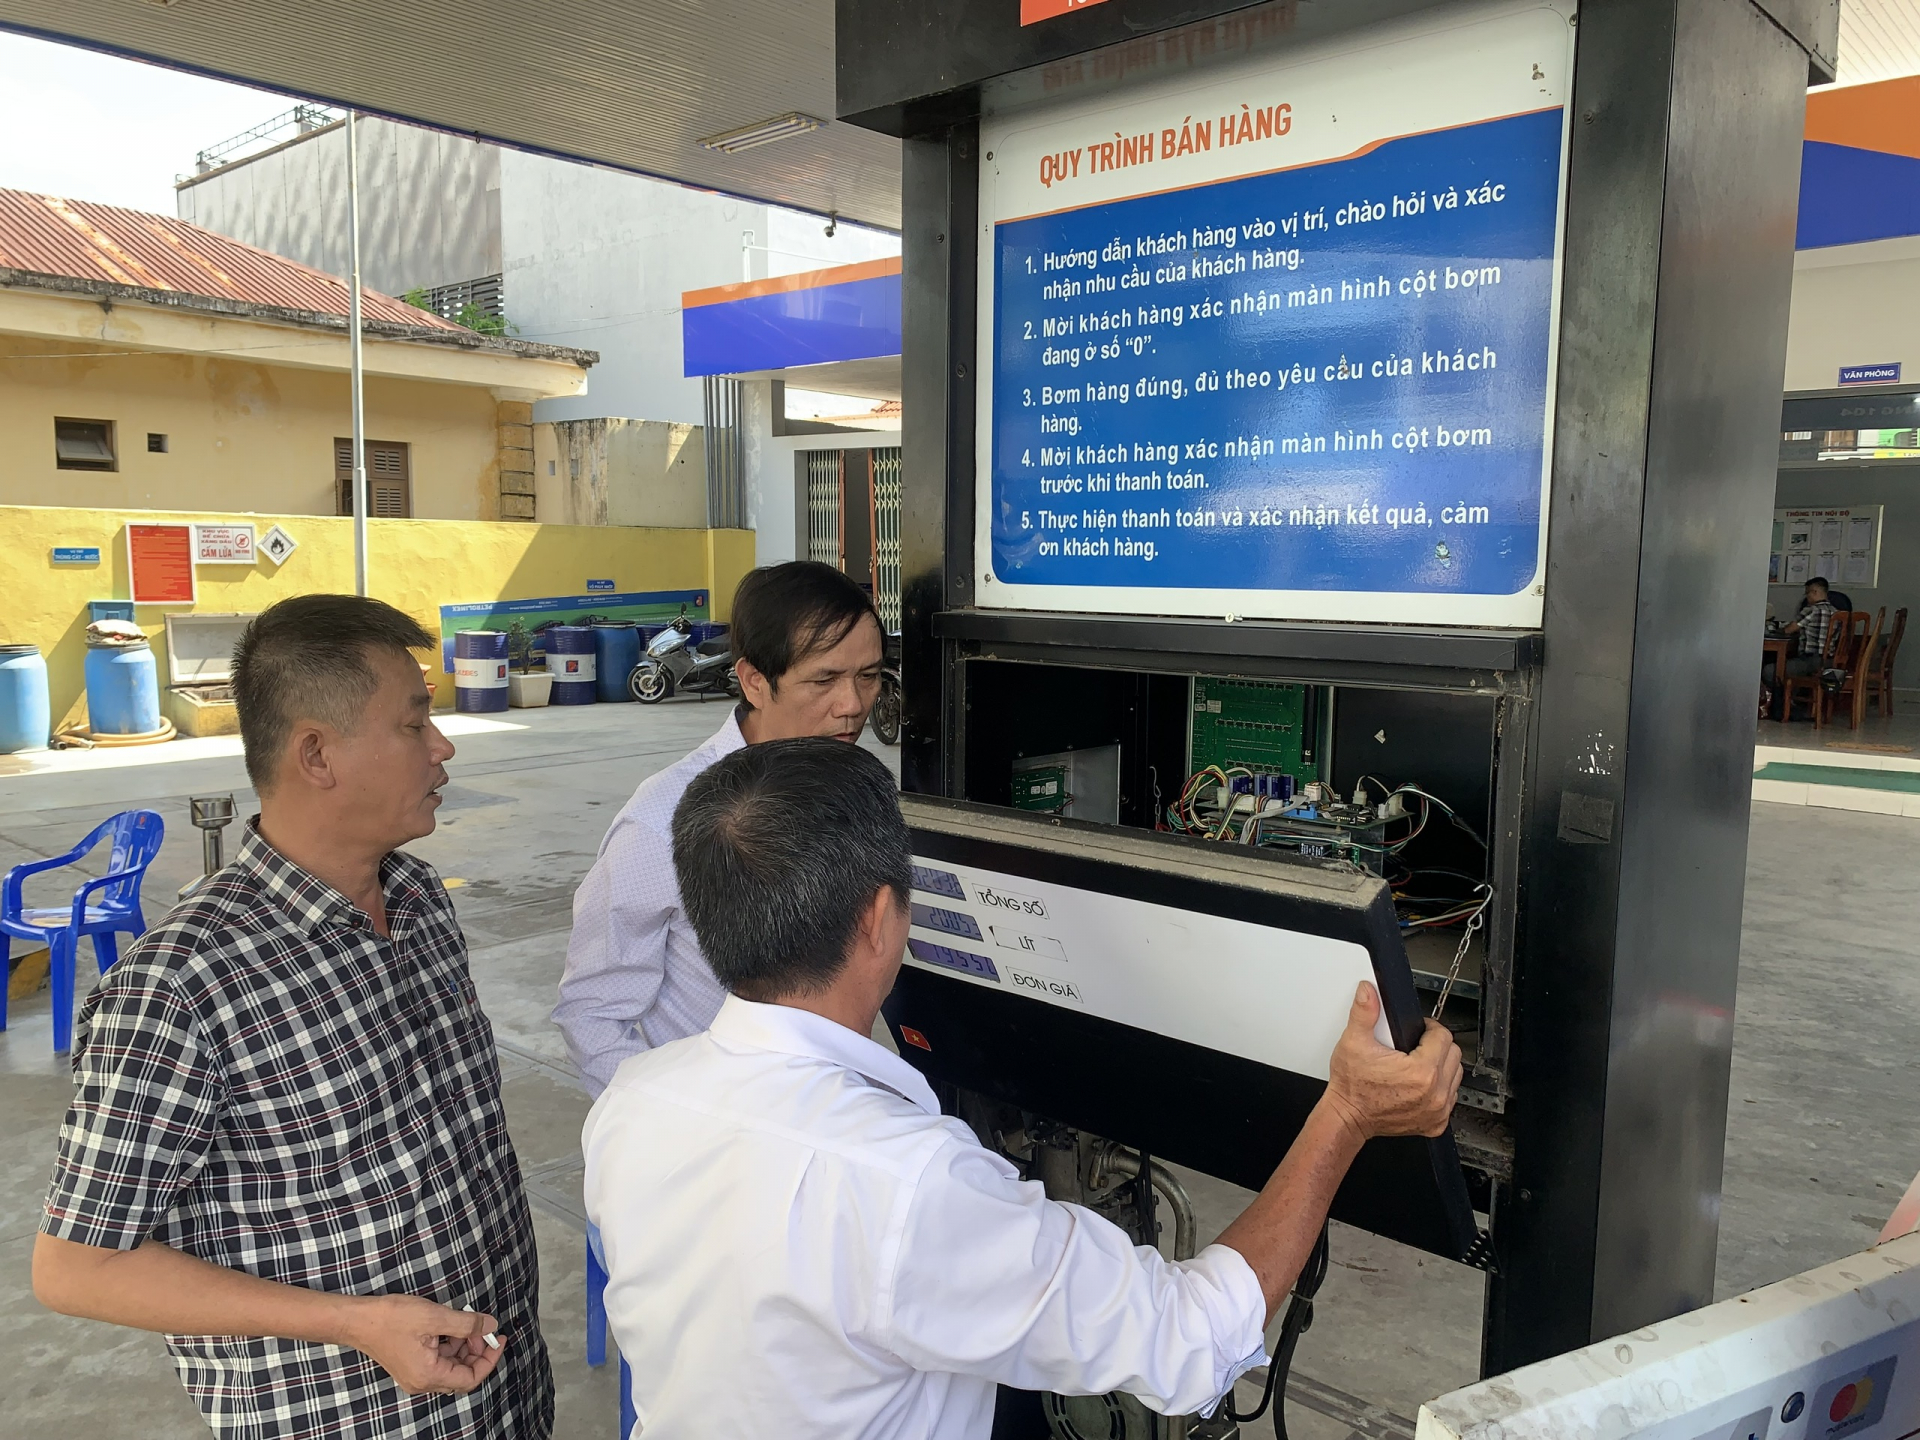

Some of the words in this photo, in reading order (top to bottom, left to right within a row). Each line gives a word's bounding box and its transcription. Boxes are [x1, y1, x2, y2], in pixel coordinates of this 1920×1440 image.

[1040, 148, 1082, 188] QUY
[1088, 132, 1153, 174] TRÌNH
[1161, 115, 1211, 160] BÁN
[1219, 103, 1292, 148] HÀNG
[1025, 255, 1037, 275] 1.
[1044, 248, 1097, 272] Hướng
[1101, 236, 1131, 262] dẫn
[1136, 230, 1187, 257] khách
[1192, 225, 1237, 248] hàng
[1242, 217, 1276, 240] vào
[1281, 211, 1298, 238] vị
[1303, 206, 1329, 232] trí,
[1335, 199, 1386, 226] chào
[1392, 191, 1426, 218] hỏi
[1432, 186, 1458, 211] và
[1464, 180, 1506, 206] xác
[1043, 278, 1081, 302] nhận
[1086, 273, 1116, 294] nhu
[1121, 263, 1150, 289] cầu
[1155, 261, 1186, 284] của
[1191, 252, 1246, 279] khách
[1252, 247, 1305, 271] hàng.
[1023, 321, 1037, 340] 2.
[1043, 315, 1073, 338] Mời
[1079, 308, 1131, 333] khách
[1138, 304, 1183, 327] hàng
[1189, 297, 1223, 320] xác
[1230, 290, 1280, 316] nhận
[1288, 283, 1333, 308] màn
[1341, 275, 1390, 301] hình
[1399, 269, 1437, 298] cột
[1445, 266, 1501, 290] bơm
[1042, 346, 1080, 368] đang
[1084, 341, 1097, 361] ở
[1100, 334, 1120, 359] số
[1022, 388, 1036, 407] 3.
[1042, 386, 1080, 406] Bơm
[1086, 381, 1129, 404] hàng
[1135, 376, 1188, 400] đúng,
[1195, 370, 1219, 392] đủ
[1225, 368, 1271, 390] theo
[1278, 362, 1316, 391] yêu
[1371, 353, 1413, 378] của
[1421, 346, 1496, 374] khách
[1844, 371, 1862, 379] VĂN
[1864, 369, 1896, 378] PHÒNG
[1041, 413, 1082, 436] hàng.
[1021, 448, 1035, 467] 4.
[1040, 446, 1071, 466] Mời
[1076, 443, 1128, 465] khách
[1133, 441, 1179, 465] hàng
[1184, 438, 1218, 460] xác
[1224, 435, 1274, 461] nhận
[1281, 432, 1326, 454] màn
[1334, 428, 1383, 452] hình
[1391, 426, 1429, 453] cột
[1436, 425, 1492, 447] bơm
[1040, 474, 1083, 494] trước
[1087, 473, 1111, 492] khi
[1115, 470, 1161, 492] thanh
[1166, 469, 1209, 490] toán.
[1021, 511, 1033, 529] 5.
[1038, 510, 1078, 533] Thực
[1082, 509, 1117, 533] hiện
[1121, 508, 1170, 528] thanh
[1175, 506, 1216, 527] toán
[1221, 505, 1243, 527] và
[1248, 505, 1283, 526] xác
[1289, 503, 1339, 530] nhận
[1346, 498, 1379, 525] kết
[1385, 501, 1433, 529] quả,
[1441, 500, 1489, 524] cảm
[201, 545, 217, 558] CẤM
[219, 545, 232, 558] LỬA
[1038, 541, 1059, 556] ơn
[1063, 537, 1109, 556] khách
[1114, 536, 1159, 561] hàng.
[978, 888, 1020, 911] TỔNG
[1023, 900, 1044, 916] SỐ
[1013, 973, 1048, 992] ĐƠN
[1049, 982, 1079, 1000] GIÁ
